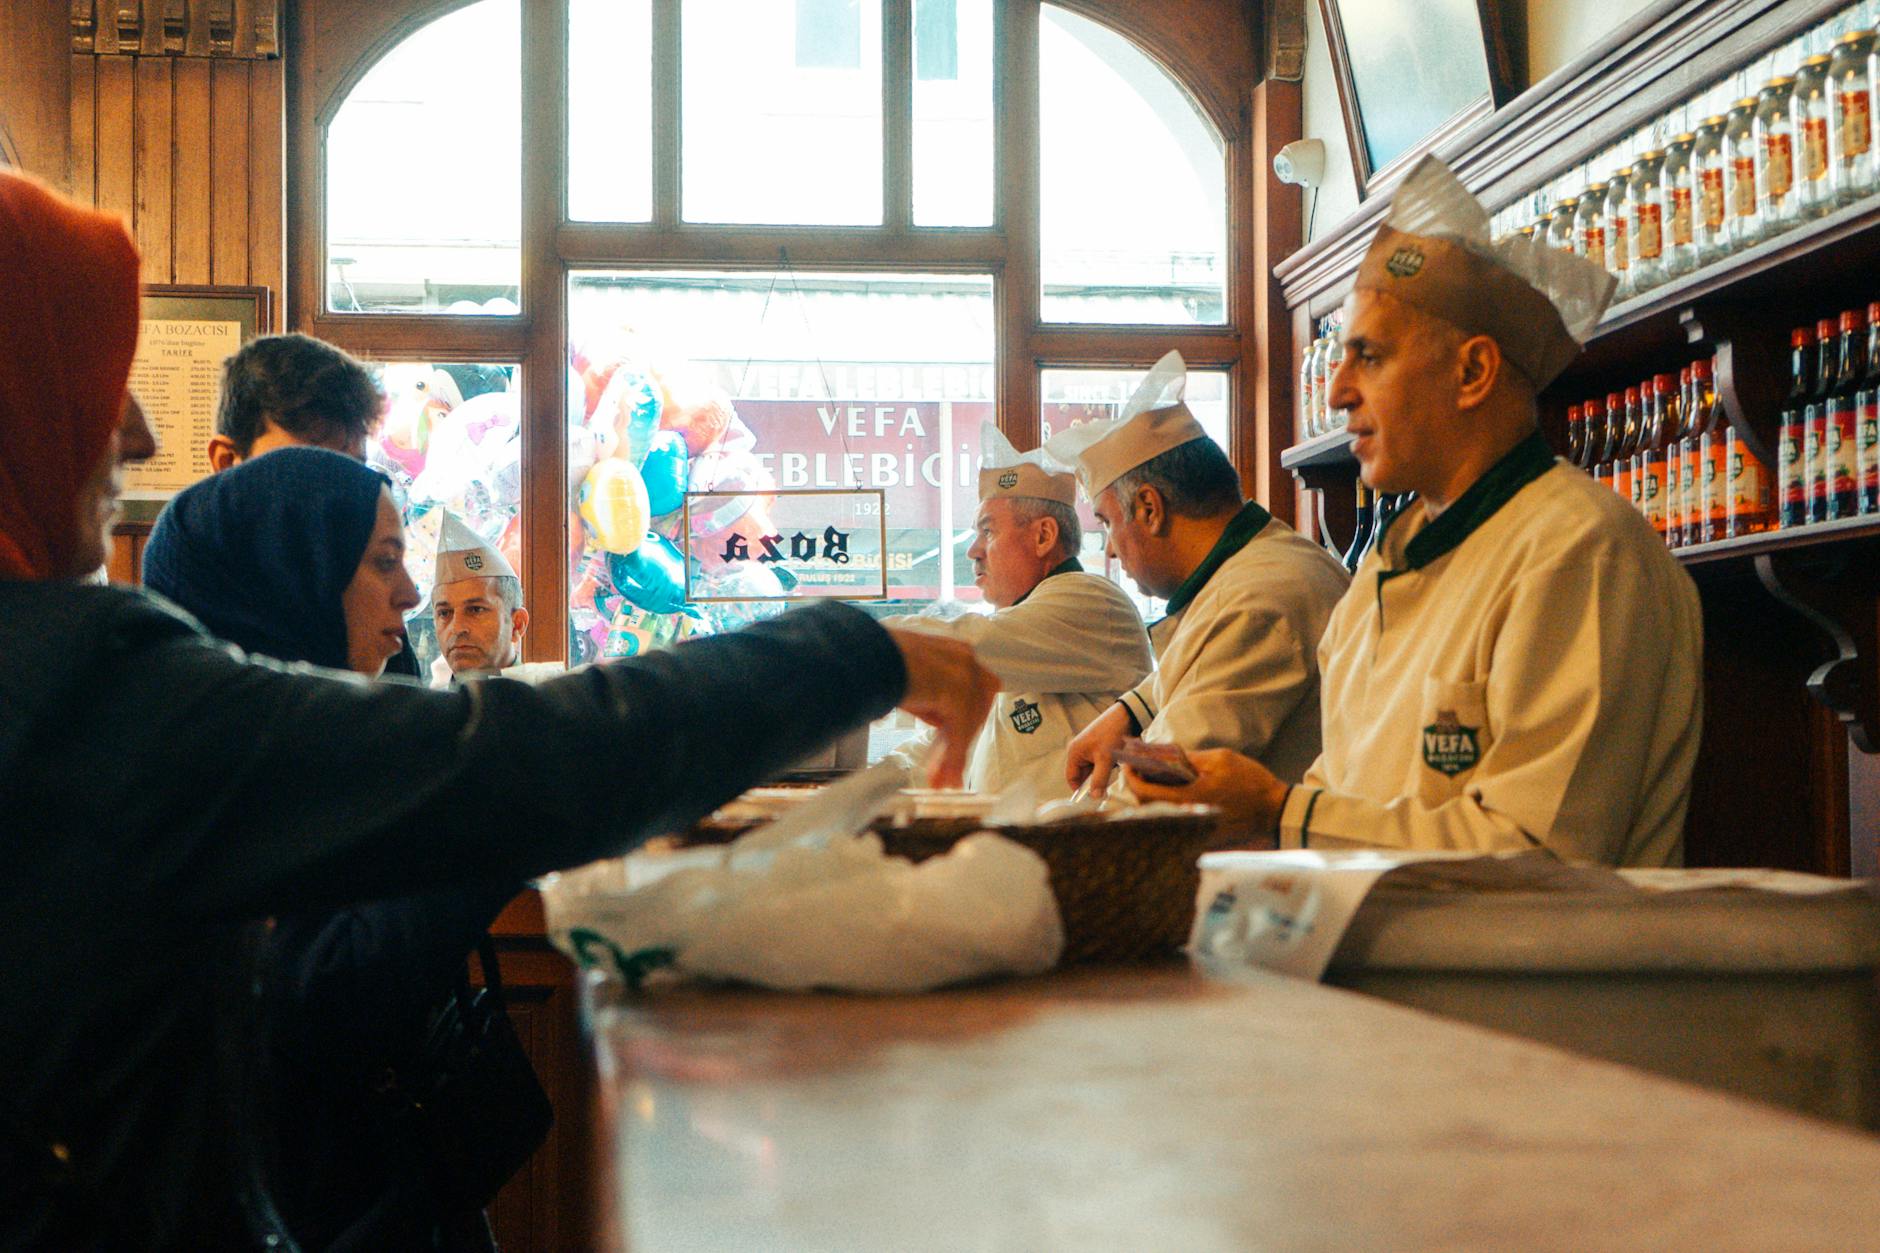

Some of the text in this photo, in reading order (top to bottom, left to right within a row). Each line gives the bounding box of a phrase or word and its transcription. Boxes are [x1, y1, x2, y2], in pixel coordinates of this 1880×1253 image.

[816, 406, 926, 438] VEFA
[1012, 707, 1039, 726] VEFA
[1424, 734, 1474, 754] VEFA
